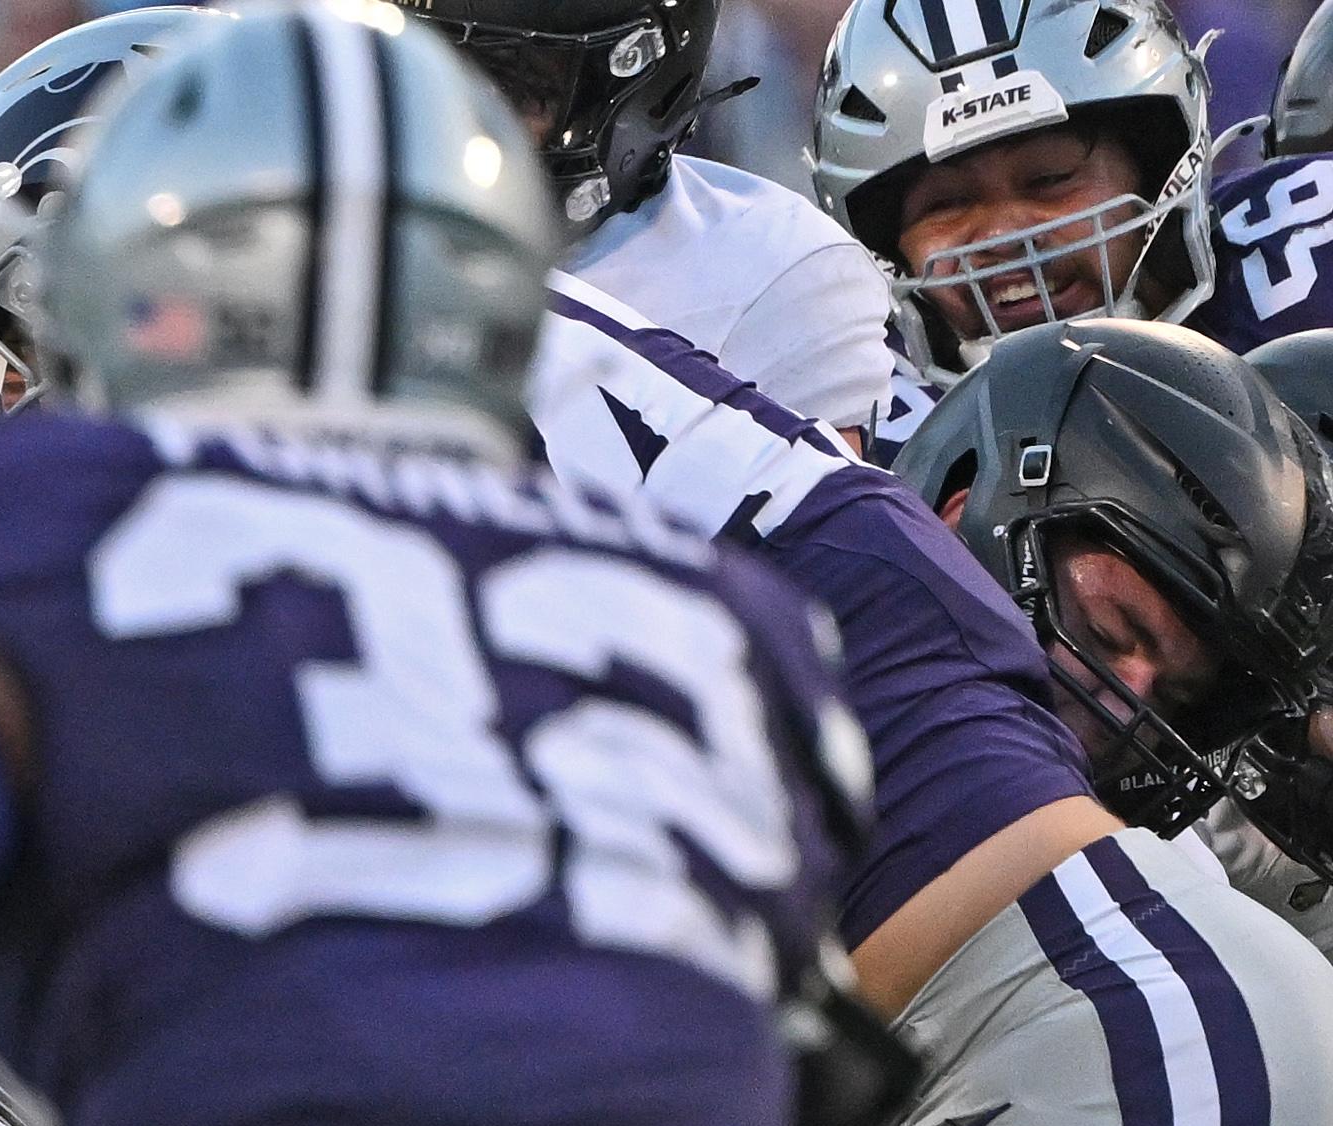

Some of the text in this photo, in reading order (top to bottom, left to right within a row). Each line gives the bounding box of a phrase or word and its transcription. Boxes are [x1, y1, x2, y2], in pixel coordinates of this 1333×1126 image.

[941, 84, 1031, 128] K-STATE
[1219, 159, 1333, 322] 56
[86, 470, 800, 1002] 32
